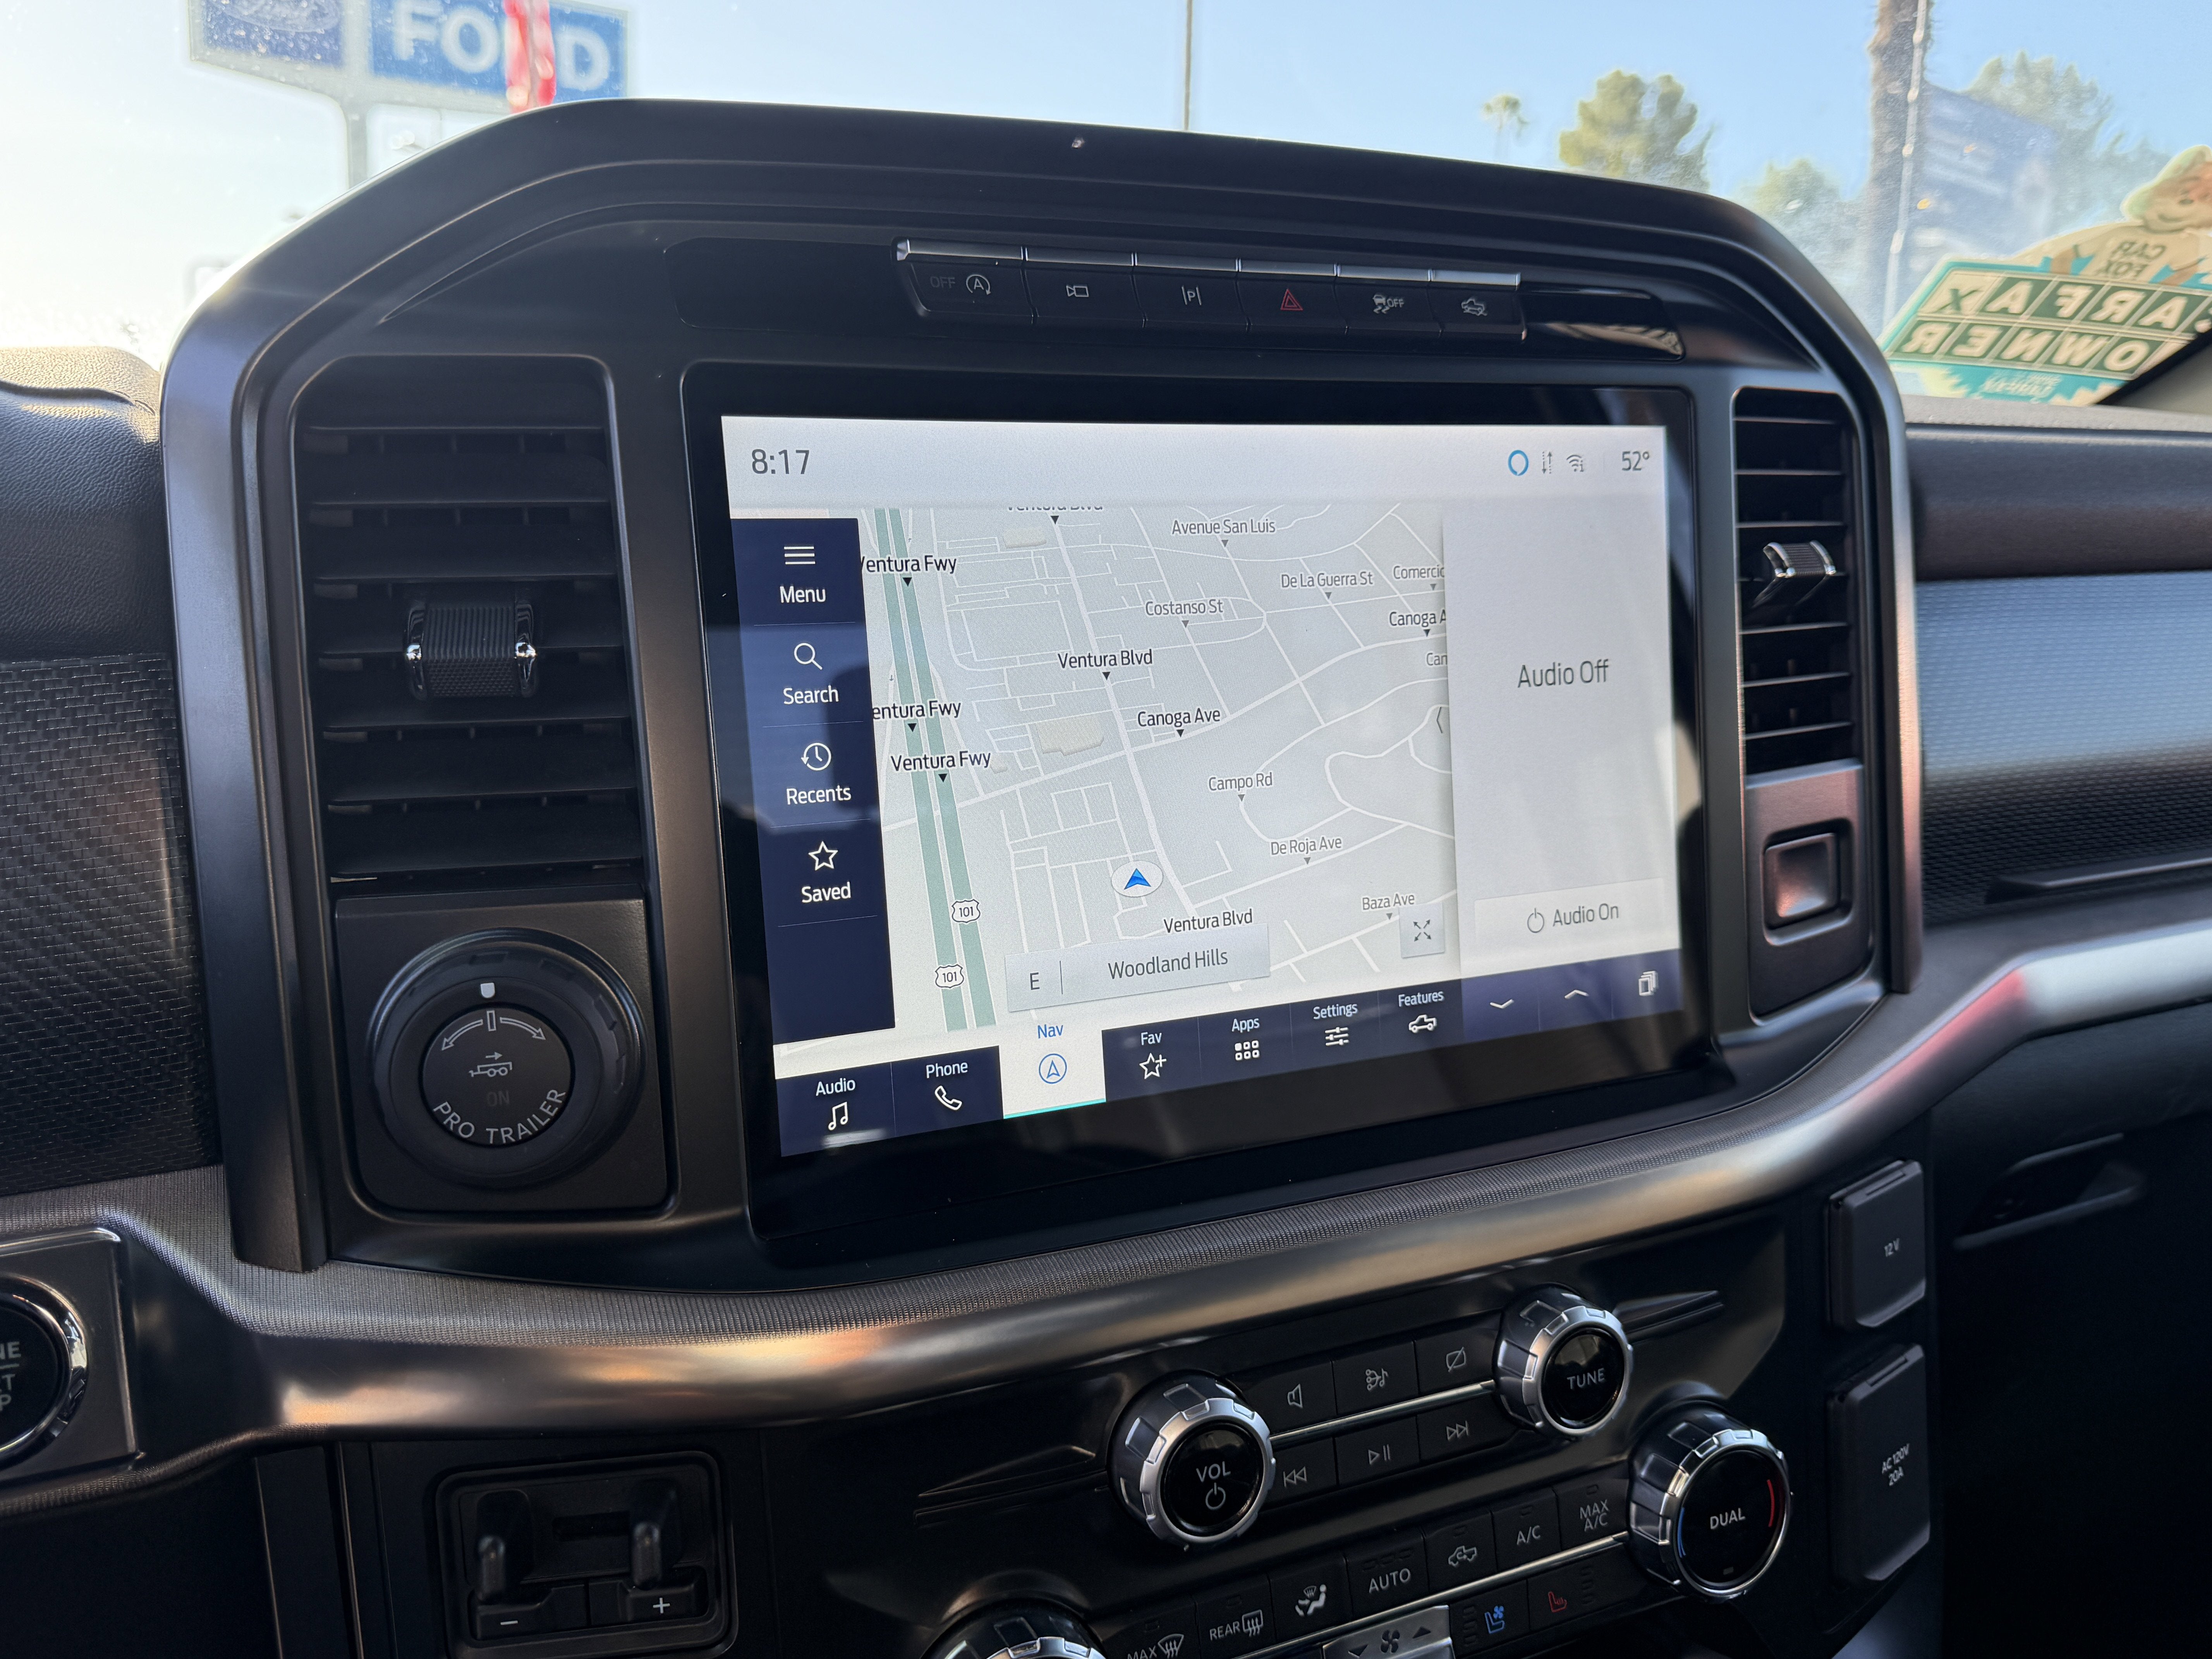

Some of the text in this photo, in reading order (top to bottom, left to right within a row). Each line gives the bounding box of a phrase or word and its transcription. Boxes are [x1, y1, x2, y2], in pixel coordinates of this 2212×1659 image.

[393, 1, 610, 91] FOD
[930, 276, 955, 288] OFF
[1387, 297, 1404, 308] OFF
[751, 449, 810, 474] 8:17
[1621, 451, 1649, 471] 52°
[1172, 519, 1275, 535] Avenue San Luis
[924, 555, 957, 574] Fwy
[1281, 571, 1373, 587] De La Guerra St
[780, 586, 826, 603] Menu
[1146, 599, 1223, 615] Costanso St
[1389, 612, 1436, 627] Canoga
[1058, 649, 1153, 668] Ventura Blvd
[1518, 659, 1609, 688] Audio Off
[783, 684, 839, 704] Search
[929, 701, 961, 718] Fwy
[1137, 708, 1221, 727] Canoga Ave
[891, 751, 991, 771] Ventura Fwy
[1208, 772, 1273, 791] Campo Rd
[787, 785, 851, 805] Recents
[1271, 836, 1342, 855] De Roja Ave
[802, 882, 851, 903] Saved
[1362, 893, 1415, 911] Baza Ave
[959, 907, 974, 917] 101
[1164, 908, 1253, 933] Ventura Blvd
[1553, 903, 1619, 926] Audio On
[1108, 948, 1228, 979] Woodland Hills
[942, 972, 957, 982] 101
[1030, 972, 1040, 990] E
[1398, 991, 1444, 1007] Features
[1313, 1003, 1358, 1020] Settings
[1037, 1024, 1063, 1039] Nav
[1231, 1017, 1260, 1033] Apps
[1141, 1032, 1162, 1046] Fav
[926, 1061, 968, 1079] Phone
[816, 1078, 855, 1096] Audio
[486, 1091, 510, 1107] ON
[433, 1089, 566, 1144] PRO TRAILER
[1884, 1238, 1900, 1257] 12V
[1567, 1367, 1605, 1389] TUNE
[1882, 1443, 1910, 1474] AC 120V
[1196, 1461, 1230, 1483] VOL
[1889, 1466, 1904, 1486] 20A
[1580, 1500, 1609, 1520] MAX
[1710, 1508, 1745, 1529] DUAL
[1584, 1513, 1608, 1532] A/C
[1517, 1525, 1541, 1545] A/C
[1369, 1568, 1411, 1593] AUTO
[1209, 1621, 1240, 1641] REAR
